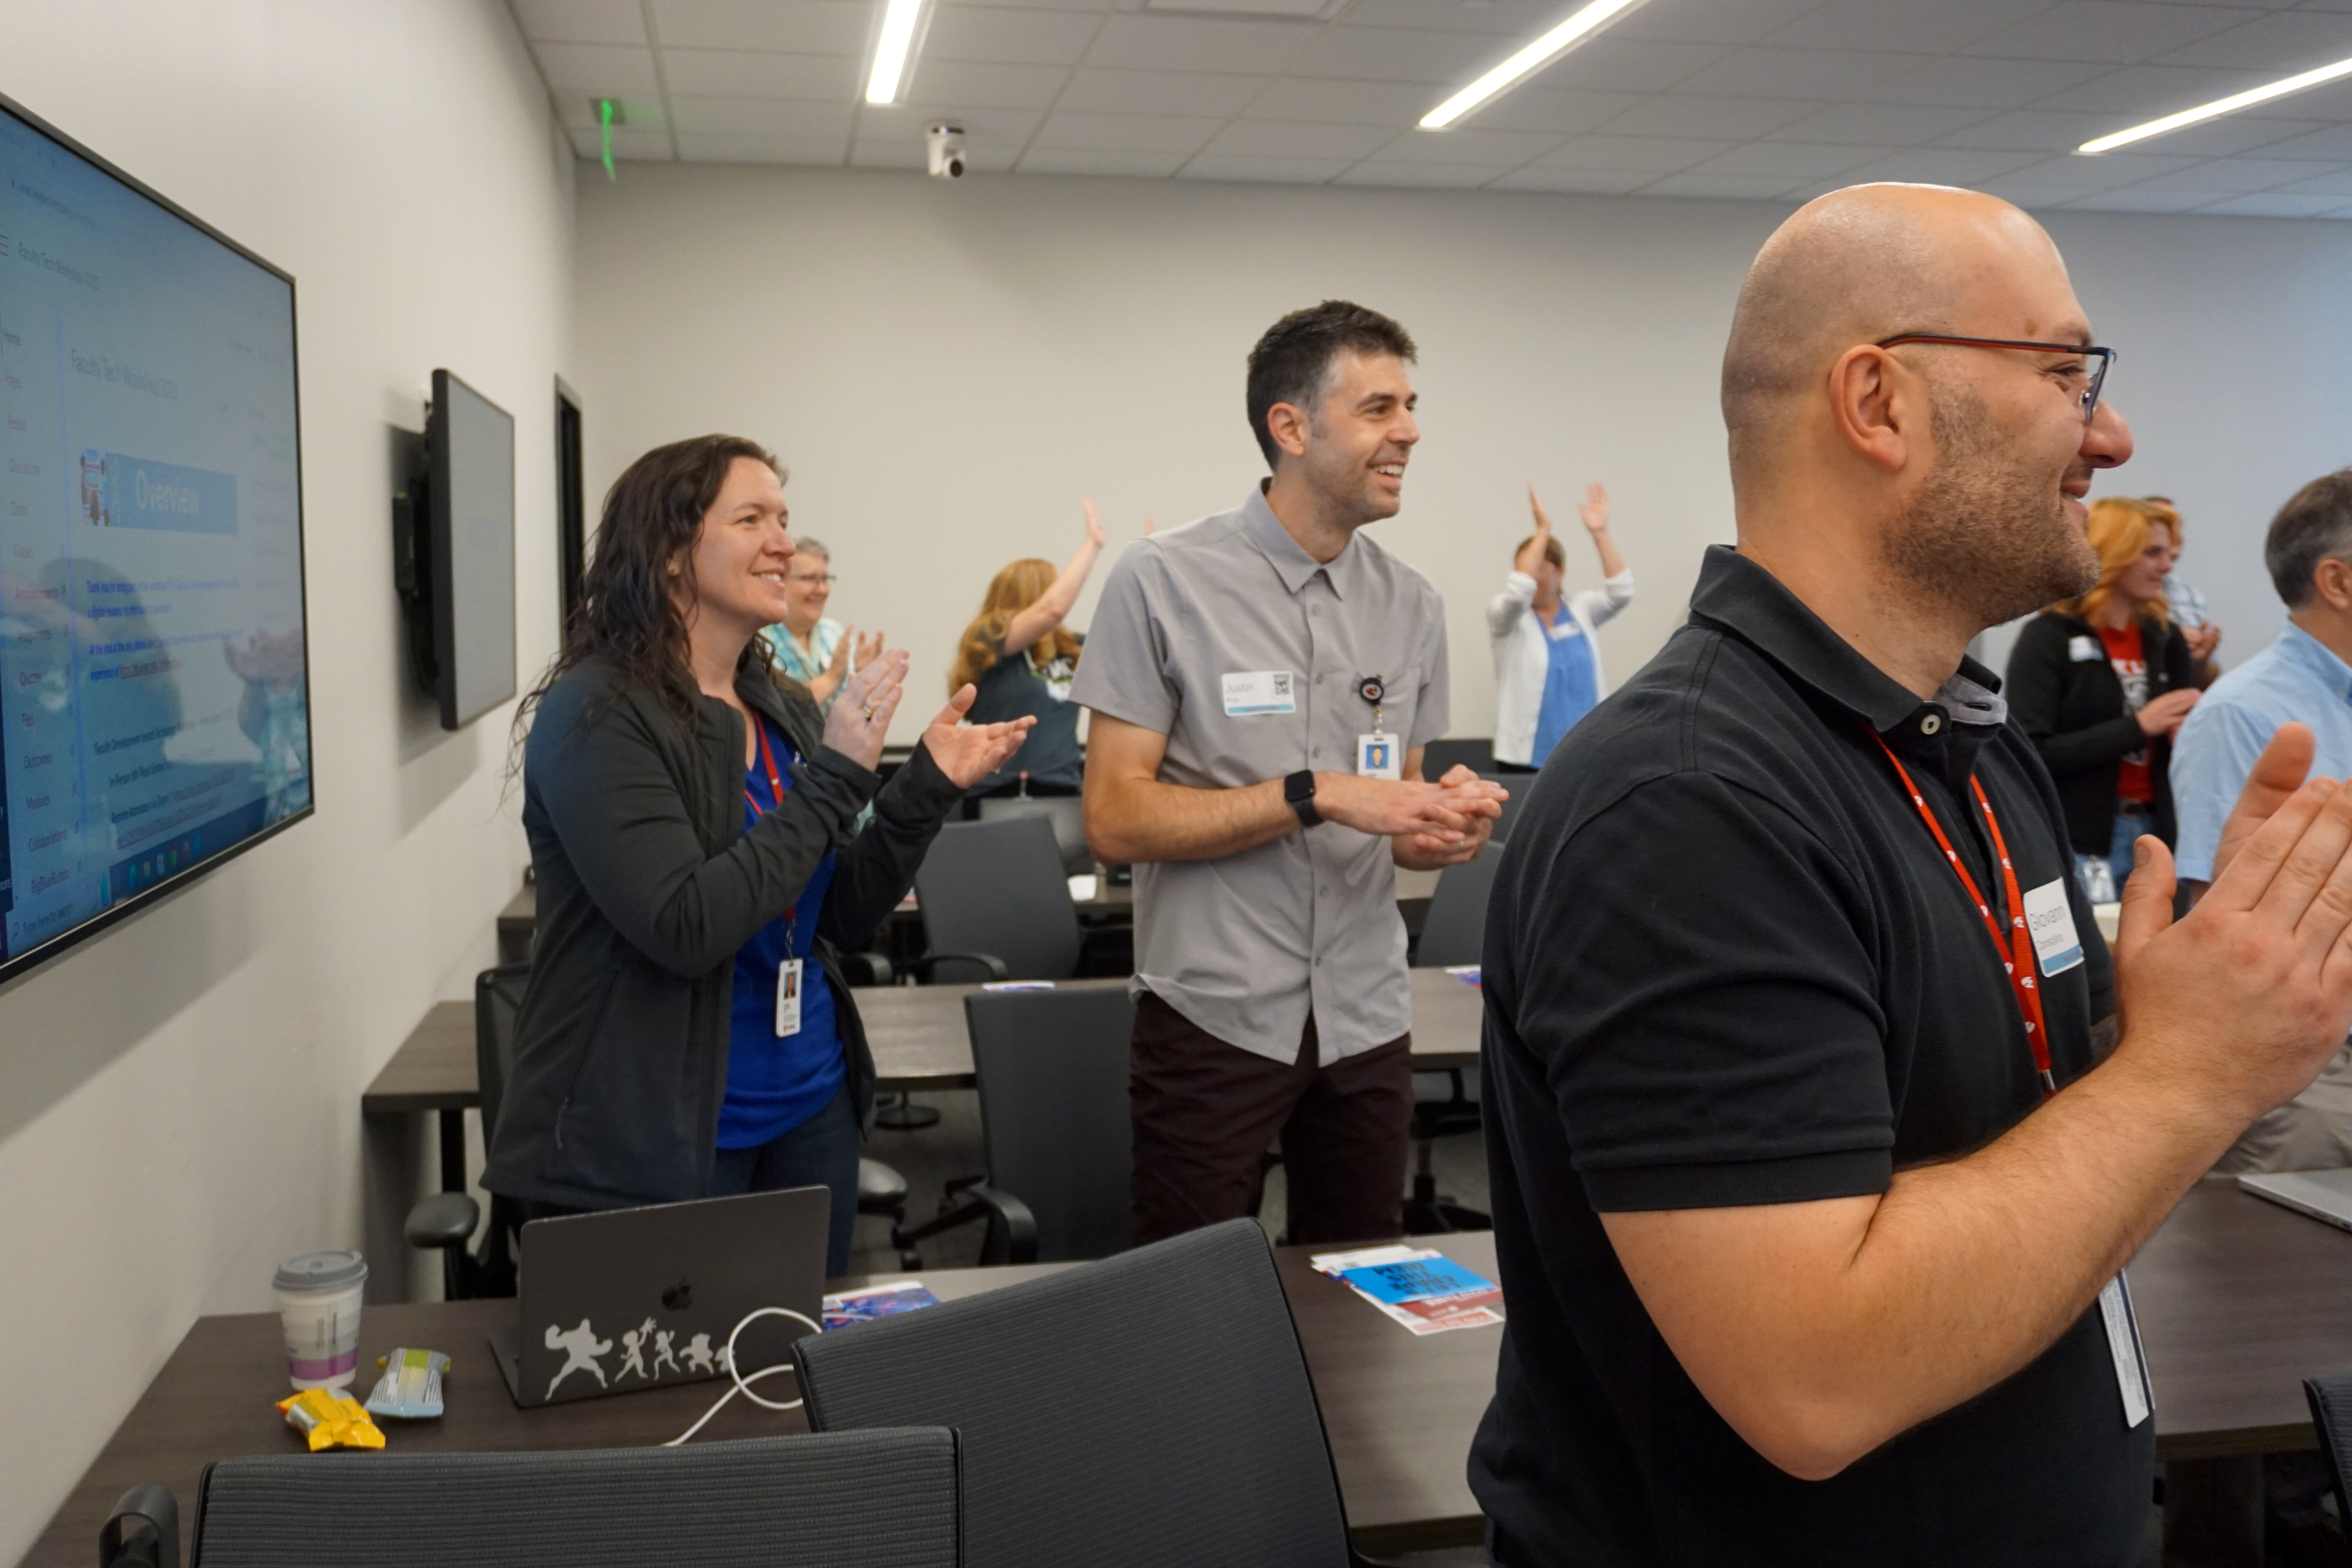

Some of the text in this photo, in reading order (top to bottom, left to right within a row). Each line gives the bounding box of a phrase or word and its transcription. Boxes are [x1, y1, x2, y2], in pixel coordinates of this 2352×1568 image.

[71, 348, 100, 383] Faculty
[102, 356, 120, 383] Tech
[122, 364, 160, 398] Workshop
[136, 469, 200, 514] Overview
[16, 587, 59, 600] Announcements
[18, 629, 52, 645] Assignments
[20, 671, 42, 687] Quizzes
[1225, 684, 1254, 693] Justin
[22, 713, 35, 726] Files
[94, 741, 111, 755] Faculty
[112, 735, 141, 751] Development
[24, 752, 53, 769] Outcomes
[26, 795, 50, 810] Modules
[29, 829, 67, 852] Collaborations
[31, 869, 69, 895] BigBlueButton
[23, 922, 36, 939] Type
[37, 915, 49, 928] here
[50, 911, 56, 923] to
[2029, 901, 2067, 931] Giovanni
